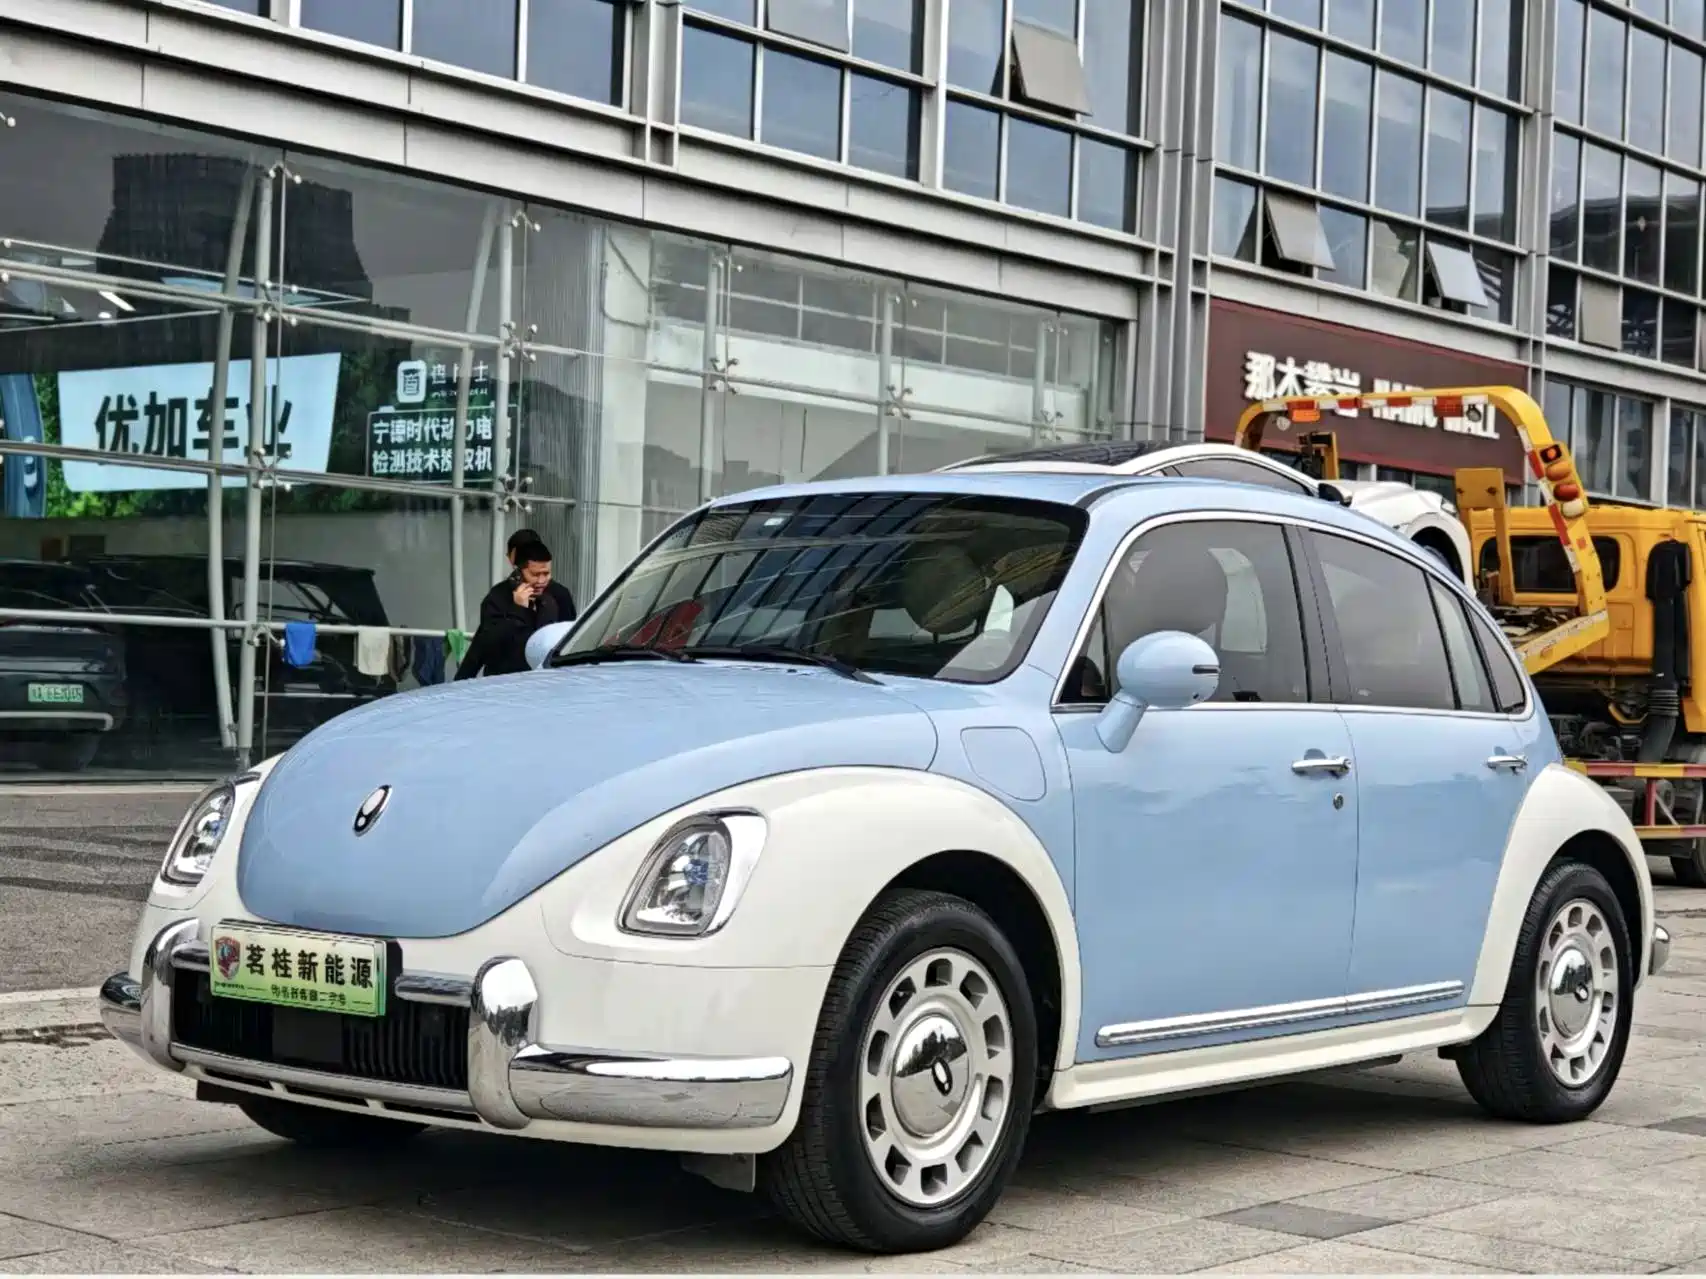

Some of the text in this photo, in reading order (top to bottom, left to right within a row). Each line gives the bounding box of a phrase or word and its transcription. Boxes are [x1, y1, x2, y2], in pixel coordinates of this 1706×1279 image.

[94, 385, 292, 459] 优加车业
[372, 415, 511, 445] 宁德时代动力电
[372, 446, 511, 475] 检测技术授权机
[245, 943, 373, 989] 茗桂新能源
